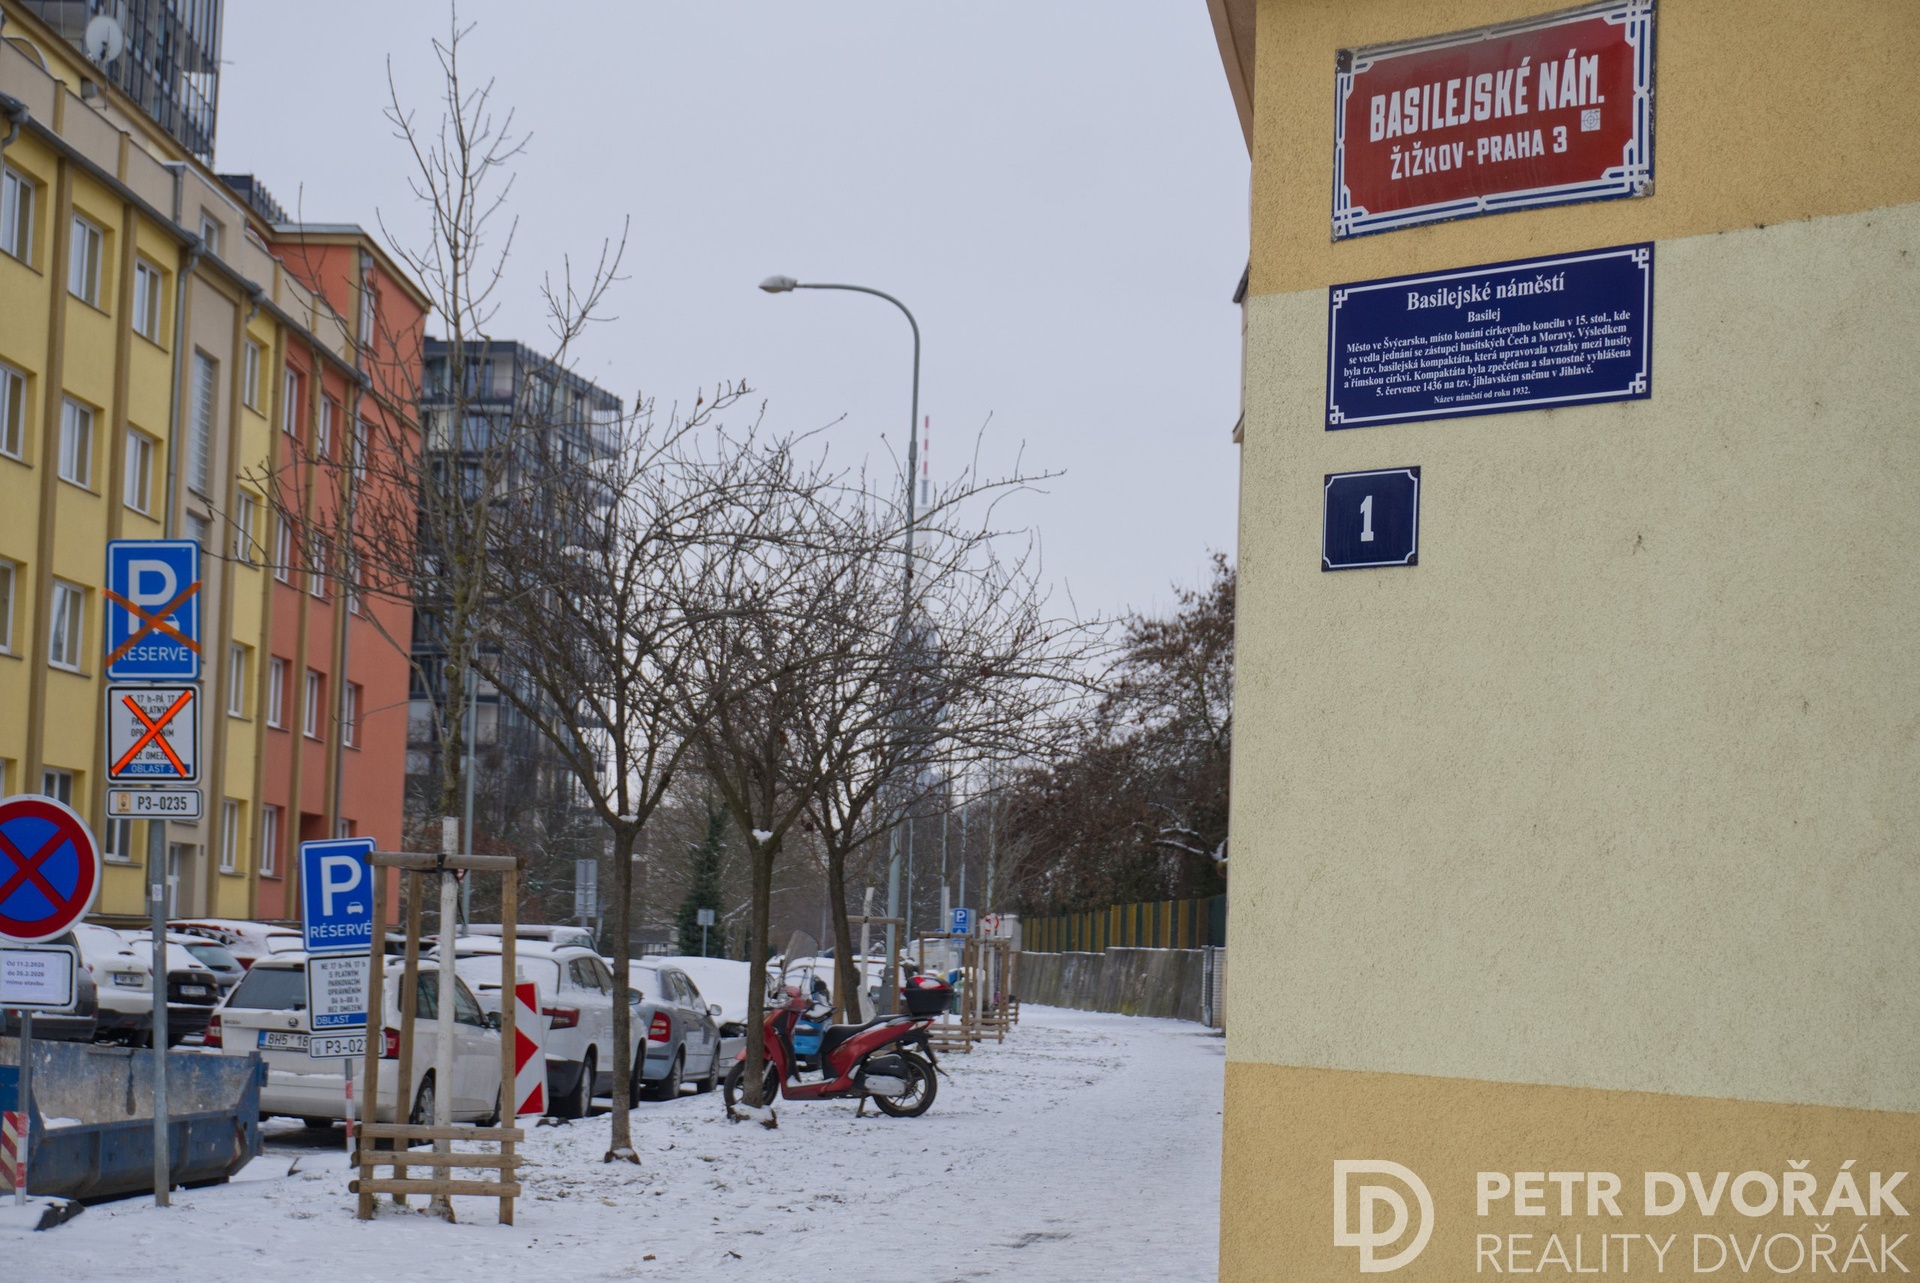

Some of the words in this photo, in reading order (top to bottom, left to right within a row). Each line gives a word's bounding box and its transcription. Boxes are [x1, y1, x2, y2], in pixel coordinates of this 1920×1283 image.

[1369, 56, 1531, 143] BASILEJSKÉ
[1538, 48, 1605, 112] NÁM.
[1552, 125, 1568, 154] 3
[1406, 281, 1491, 310] Basilejské
[1496, 272, 1564, 299] náměstí
[1346, 342, 1371, 353] Město
[1383, 335, 1428, 350] Švýcarsku,
[1429, 332, 1452, 343] místo
[1454, 327, 1483, 340] konání
[1484, 322, 1531, 336] církevního
[1532, 317, 1565, 330] koncilu
[1567, 318, 1572, 326] v
[1575, 314, 1588, 325] 15.
[1590, 312, 1611, 323] stol.,
[1613, 309, 1630, 321] kde
[1467, 307, 1500, 322] Basilej
[1343, 366, 1361, 378] byla
[1362, 366, 1376, 374] tzv.
[1378, 358, 1418, 372] basilejská
[1420, 353, 1472, 368] kompaktáta,
[1474, 349, 1497, 361] která
[1499, 344, 1547, 360] upravovala
[1549, 341, 1578, 353] vztahy
[1581, 337, 1602, 349] mezi
[1604, 335, 1631, 347] husity
[1348, 356, 1357, 364] se
[1358, 352, 1380, 363] vedla
[1382, 347, 1412, 363] jednání
[1424, 342, 1458, 355] zástupci
[1460, 337, 1505, 351] husitských
[1506, 333, 1529, 345] Čech
[1530, 335, 1536, 343] a
[1539, 331, 1575, 342] Moravy.
[1577, 324, 1626, 339] Výsledkem
[1350, 376, 1384, 387] římskou
[1385, 371, 1412, 383] církví.
[1413, 366, 1465, 380] Kompaktáta
[1467, 363, 1486, 376] byla
[1487, 359, 1529, 374] zpečetěna
[1531, 359, 1537, 367] a
[1538, 352, 1585, 366] slavnostně
[1586, 348, 1631, 363] vyhlášena
[1375, 386, 1383, 397] 5.
[1385, 385, 1421, 395] července
[1423, 380, 1442, 391] 1436
[1443, 381, 1454, 389] na
[1456, 379, 1471, 387] tzv.
[1473, 372, 1519, 388] jihlavském
[1521, 369, 1549, 380] sněmu
[1550, 369, 1557, 377] v
[1558, 363, 1594, 376] Jihlavě.
[1434, 395, 1455, 404] Název
[1456, 390, 1483, 402] náměstí
[1484, 390, 1493, 399] od
[1494, 387, 1511, 397] roku
[1512, 386, 1531, 396] 1932.
[1360, 495, 1374, 542] 1
[131, 764, 165, 773] OBLAST
[137, 796, 187, 810] P3-0235
[320, 855, 362, 916] P
[309, 919, 372, 939] RÉSERVÉ
[316, 1015, 350, 1025] OBLAST
[325, 1038, 367, 1054] P3-02
